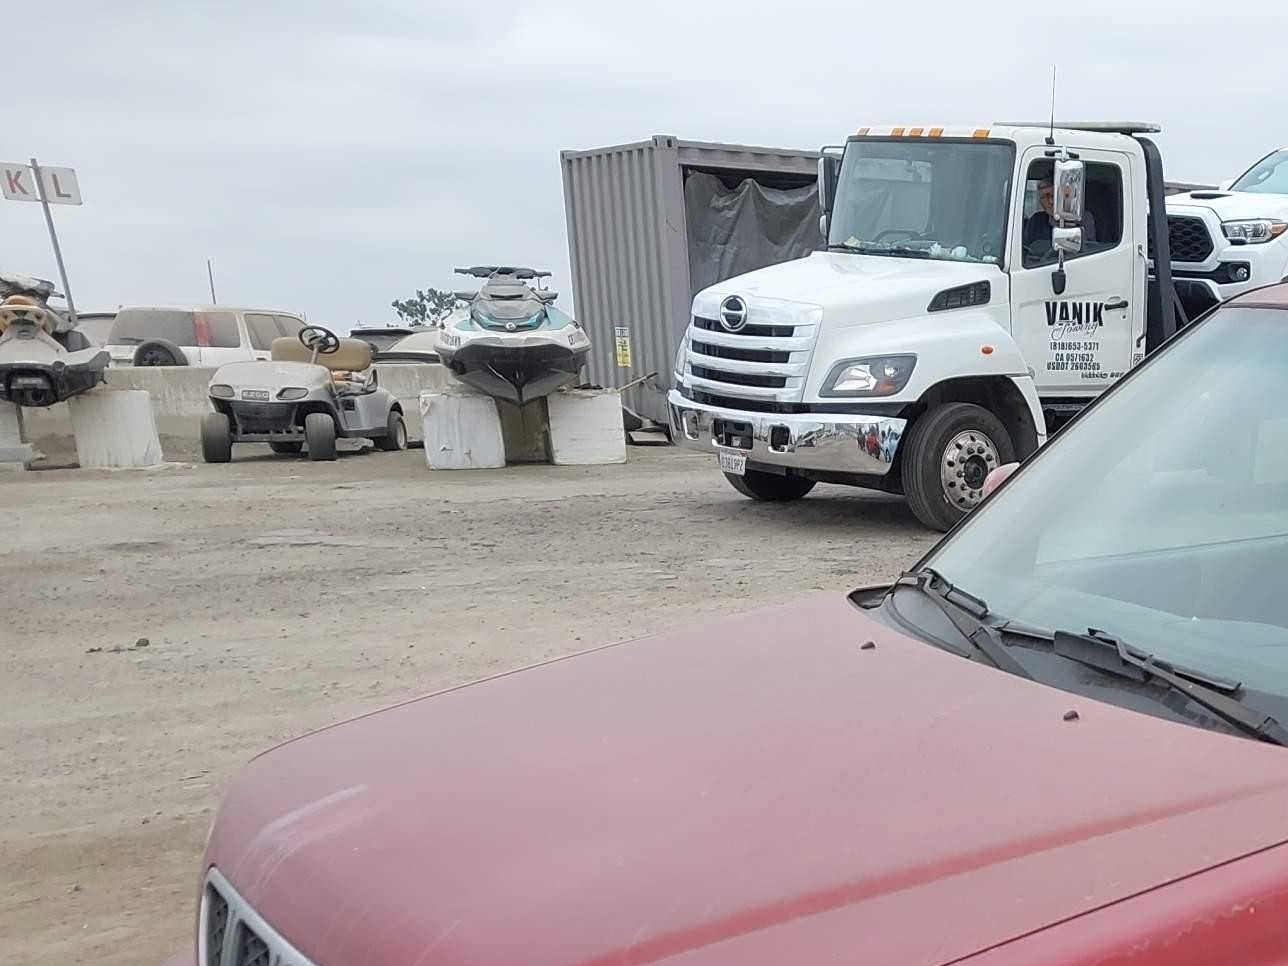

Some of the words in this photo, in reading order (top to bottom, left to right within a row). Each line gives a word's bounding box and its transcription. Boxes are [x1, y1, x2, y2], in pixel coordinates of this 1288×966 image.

[5, 169, 28, 195] K
[51, 173, 72, 198] L
[1045, 301, 1104, 326] VANIK
[1047, 362, 1069, 371] USDOT
[1055, 353, 1064, 362] CA
